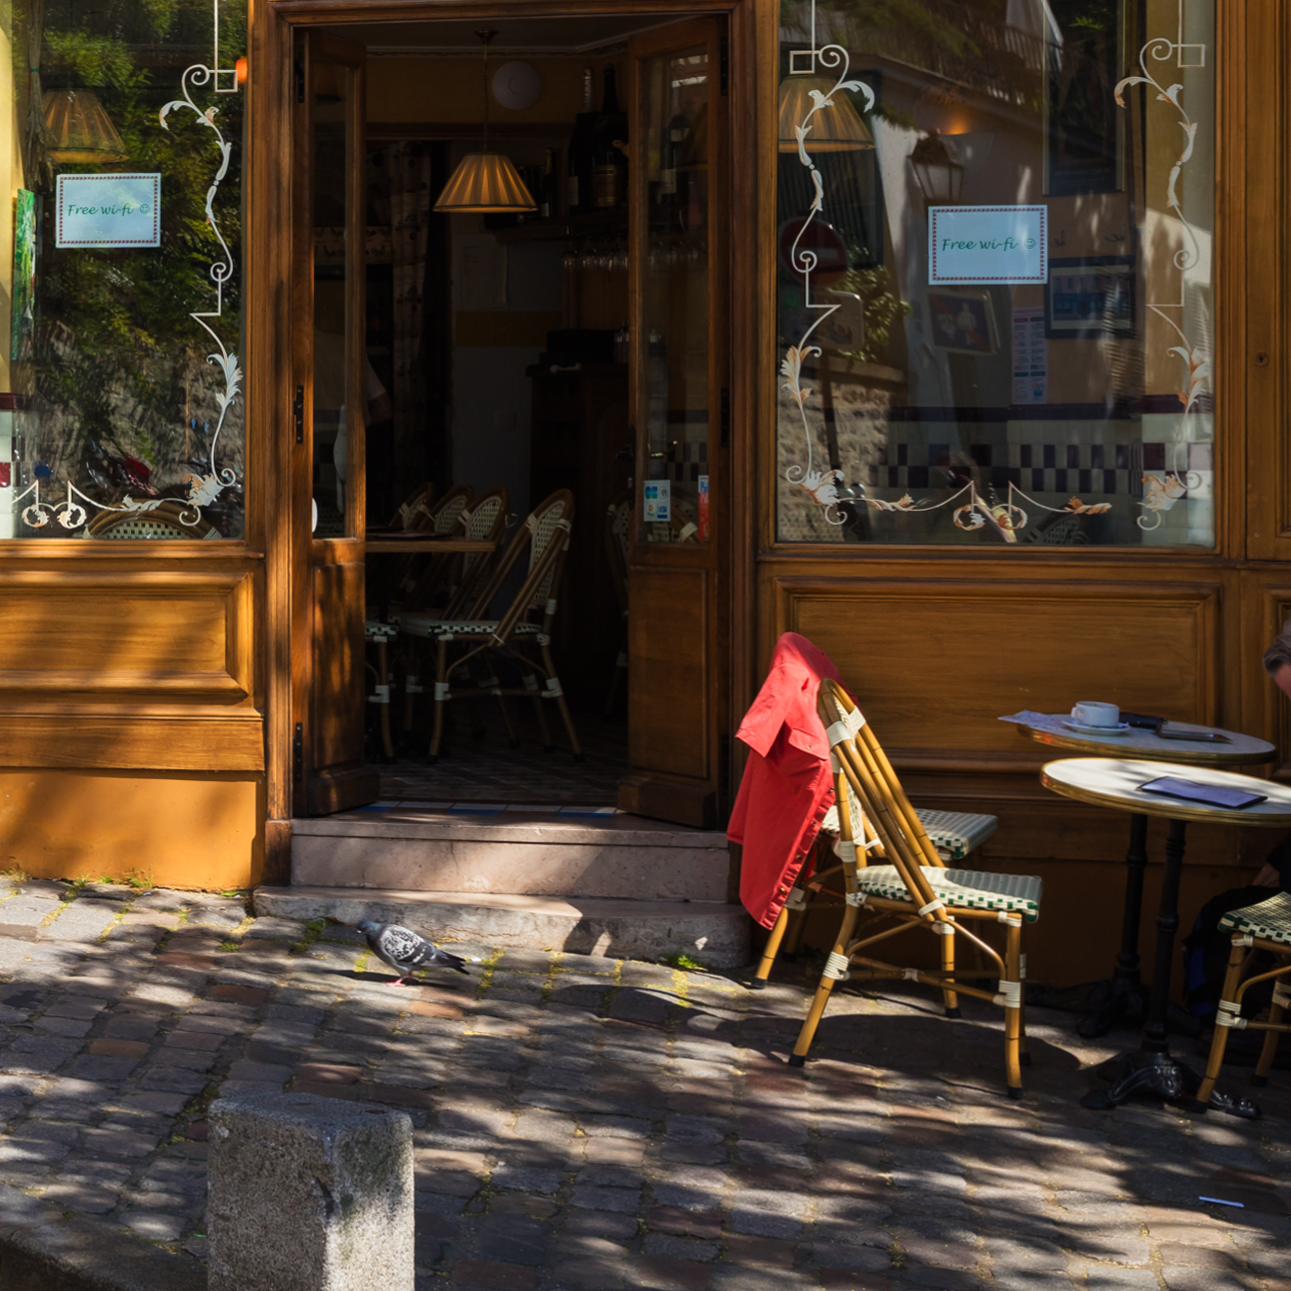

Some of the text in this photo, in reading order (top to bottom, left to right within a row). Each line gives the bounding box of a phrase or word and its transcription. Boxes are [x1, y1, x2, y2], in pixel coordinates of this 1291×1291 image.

[68, 203, 135, 216] Free wi-fi
[941, 237, 1018, 252] Free wi-fi
